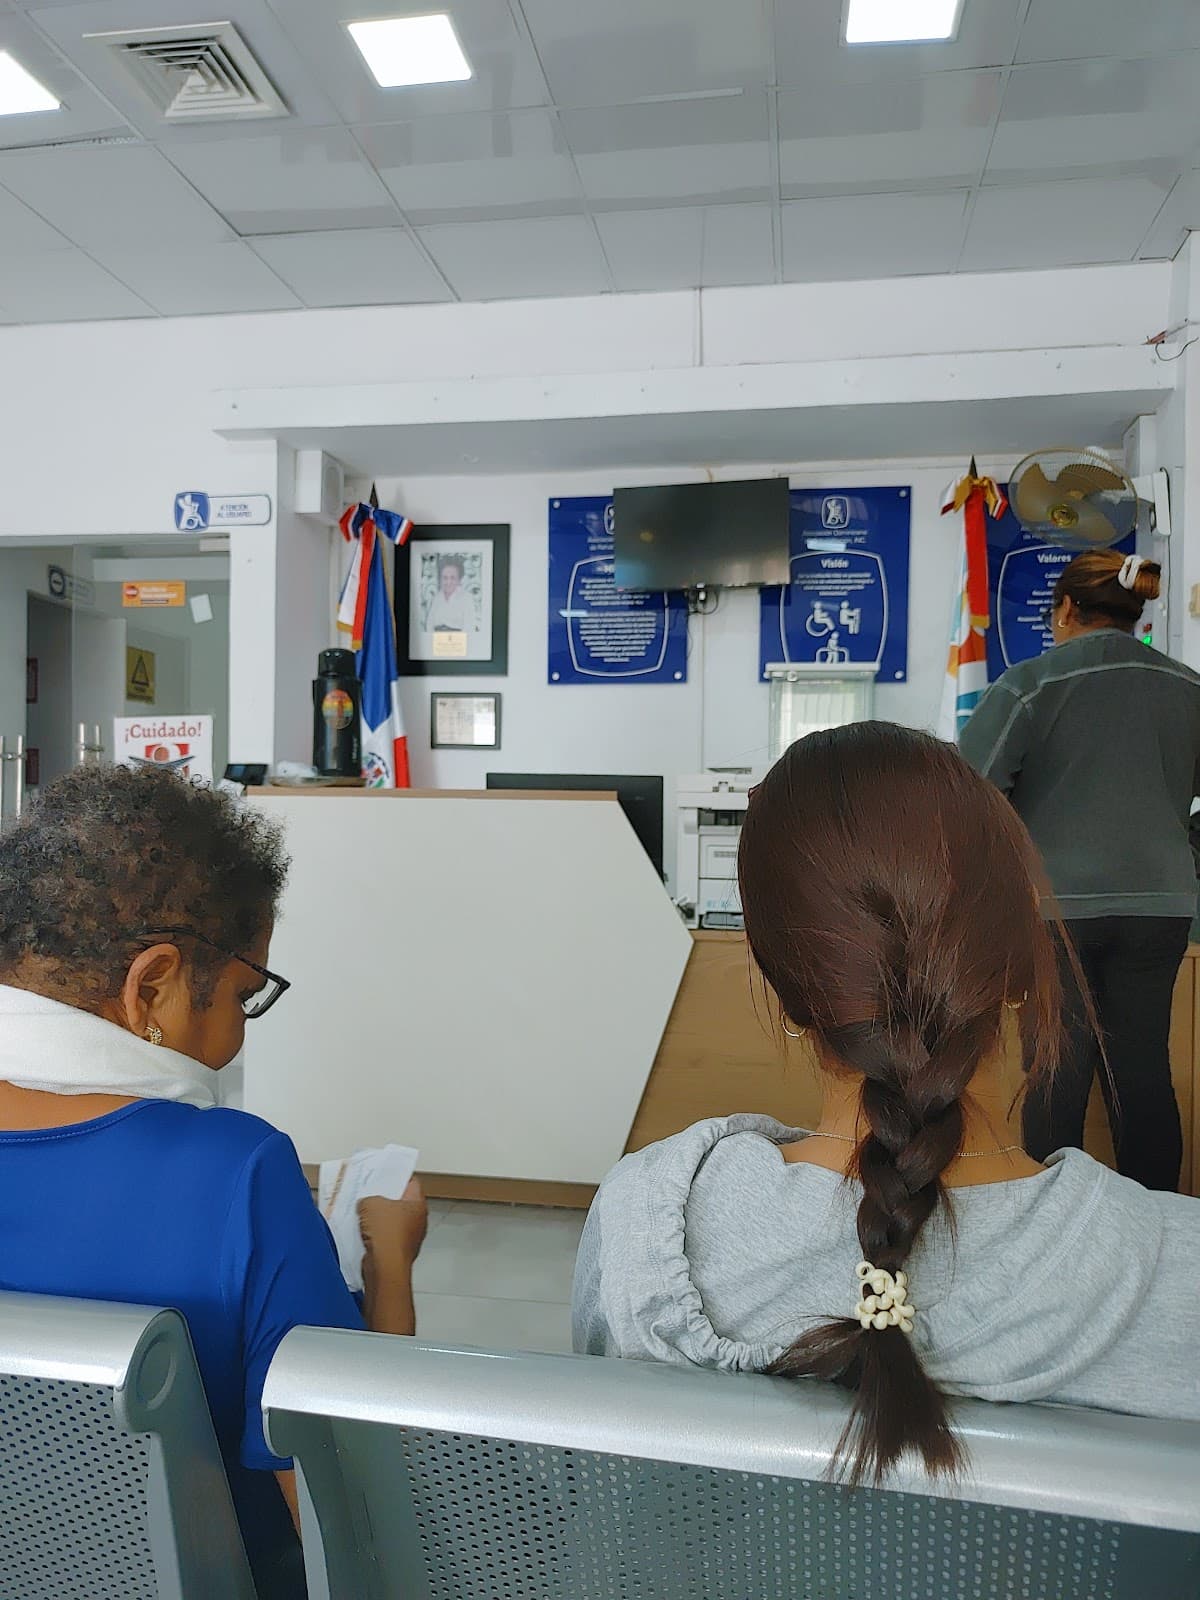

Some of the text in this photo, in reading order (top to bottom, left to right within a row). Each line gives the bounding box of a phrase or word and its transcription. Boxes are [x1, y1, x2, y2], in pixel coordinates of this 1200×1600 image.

[821, 557, 849, 569] Visión
[1037, 553, 1072, 563] Valores
[125, 721, 202, 744] ¡Cuidado!
